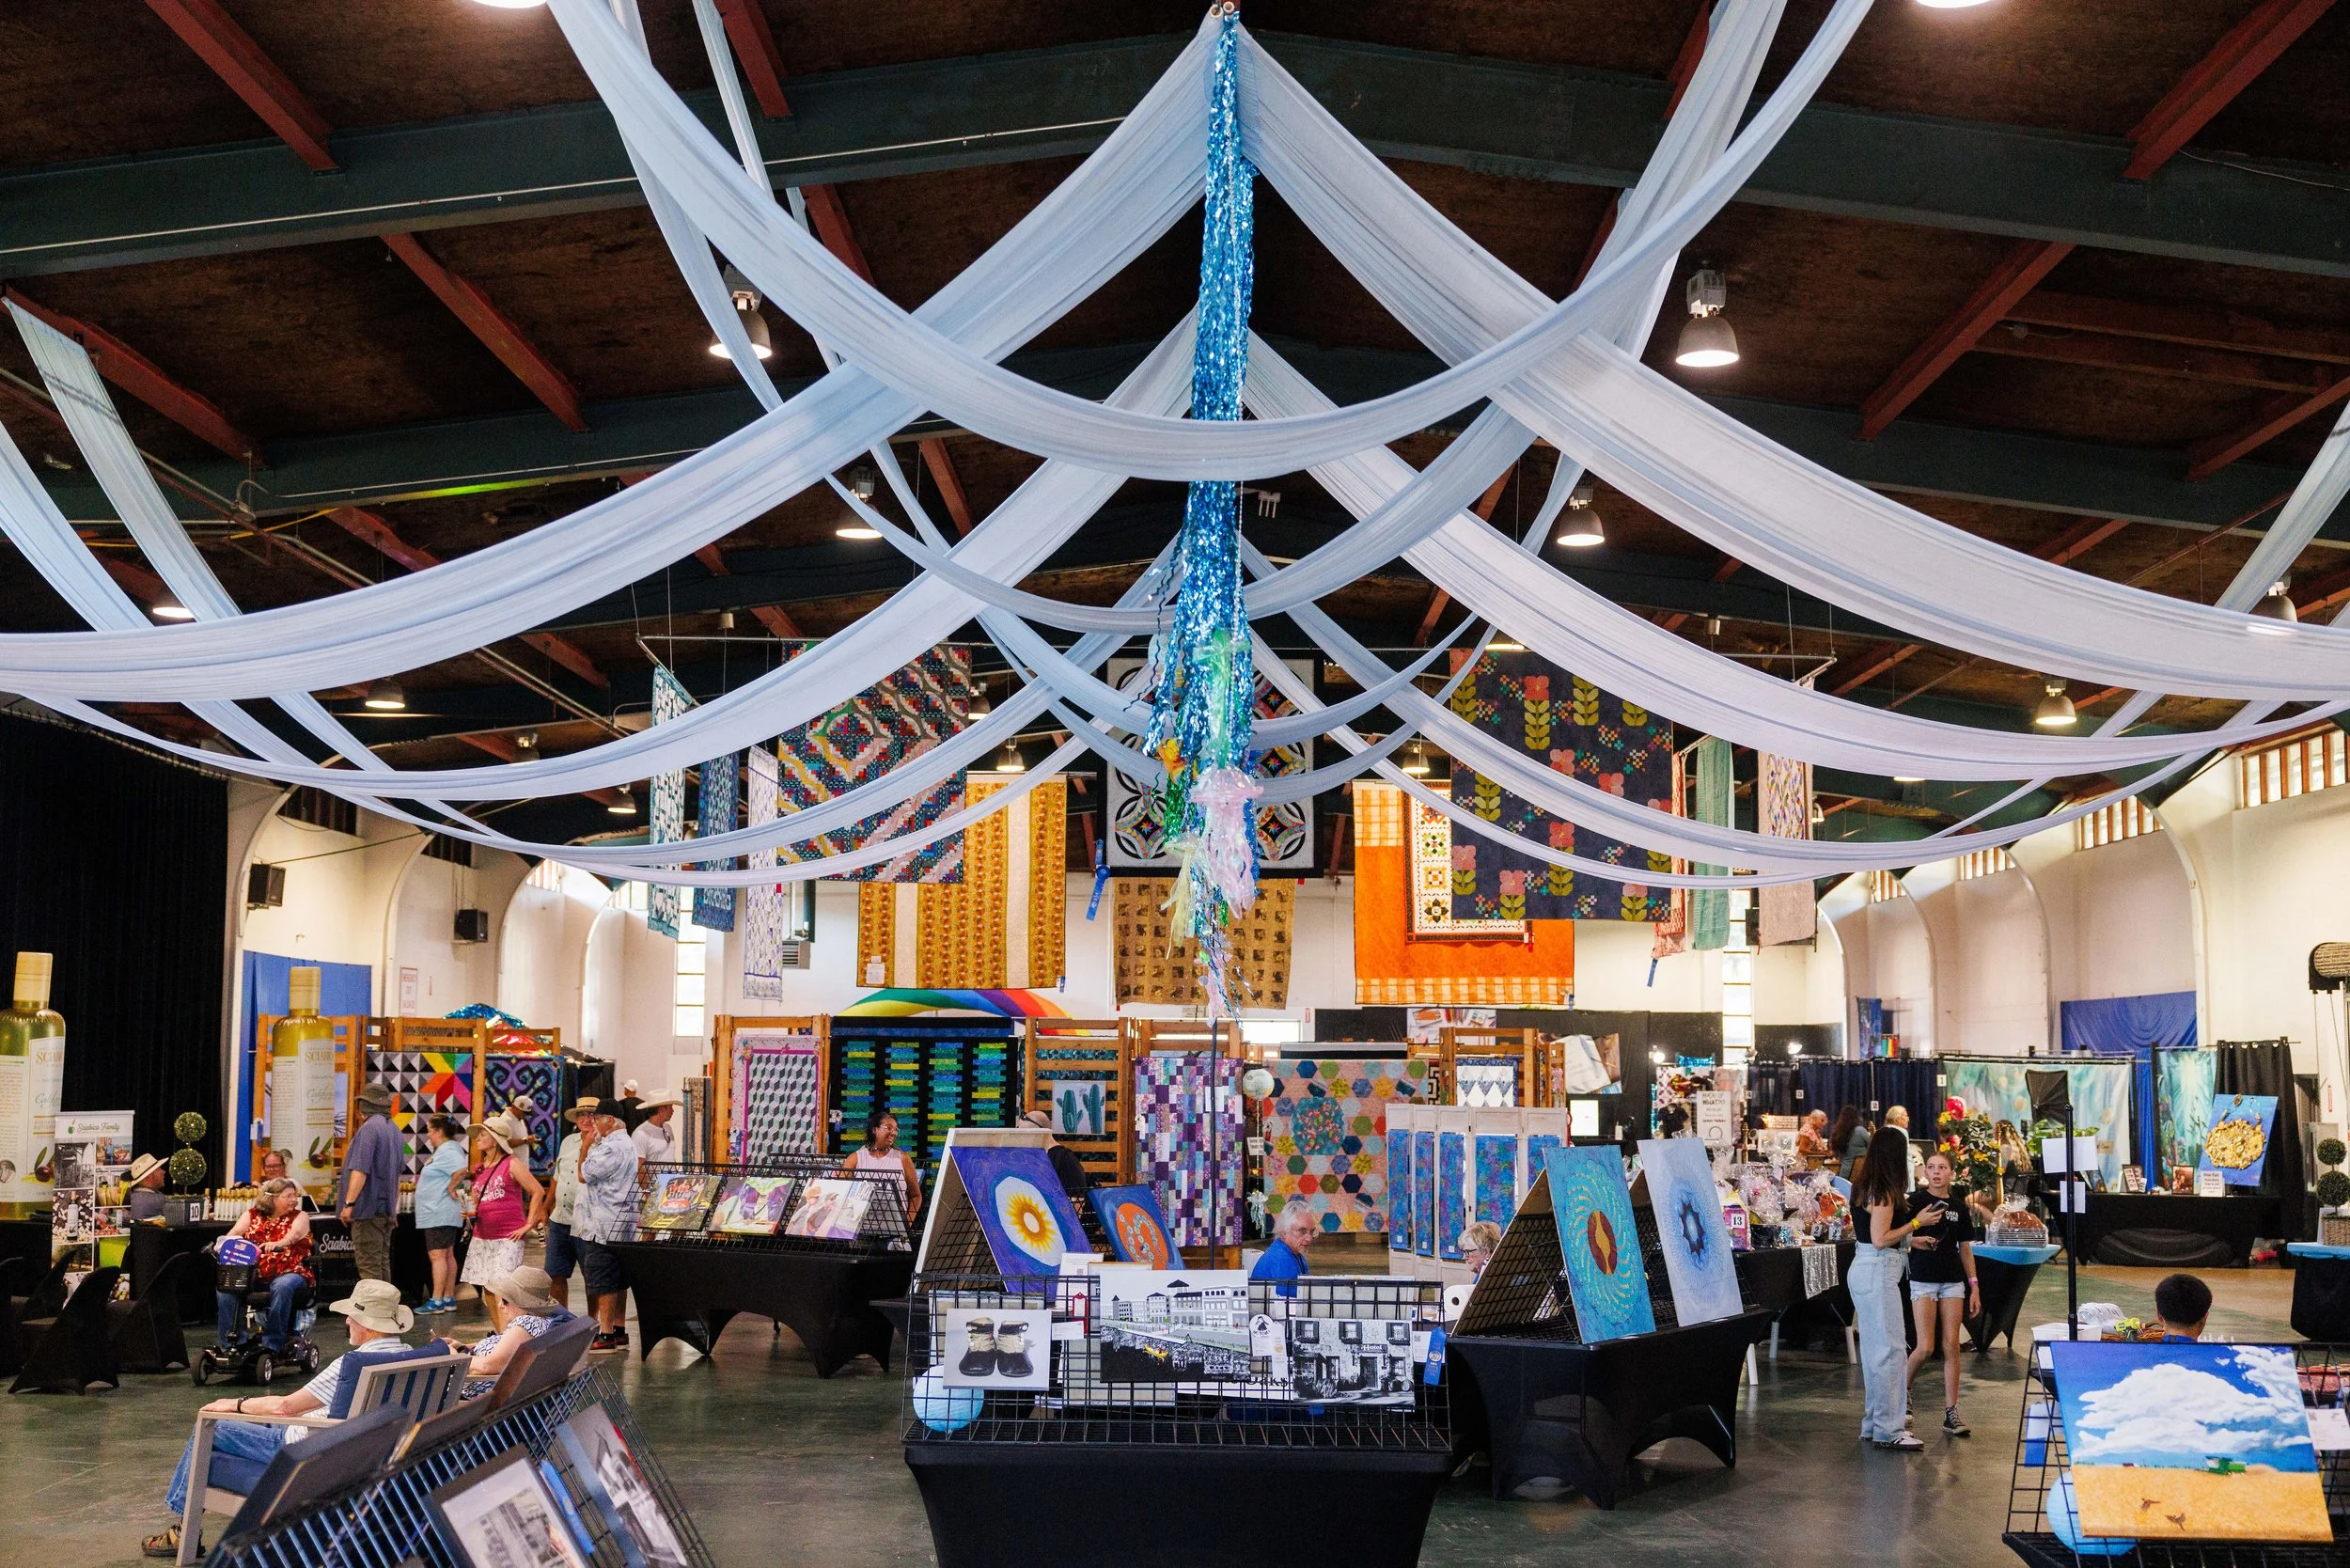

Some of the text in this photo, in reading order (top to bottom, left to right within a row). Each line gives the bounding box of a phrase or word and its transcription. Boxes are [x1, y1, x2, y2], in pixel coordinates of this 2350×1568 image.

[101, 1121, 120, 1132] Family
[190, 1206, 200, 1218] 10
[1732, 1216, 1743, 1226] 13
[1814, 1226, 1820, 1234] 2
